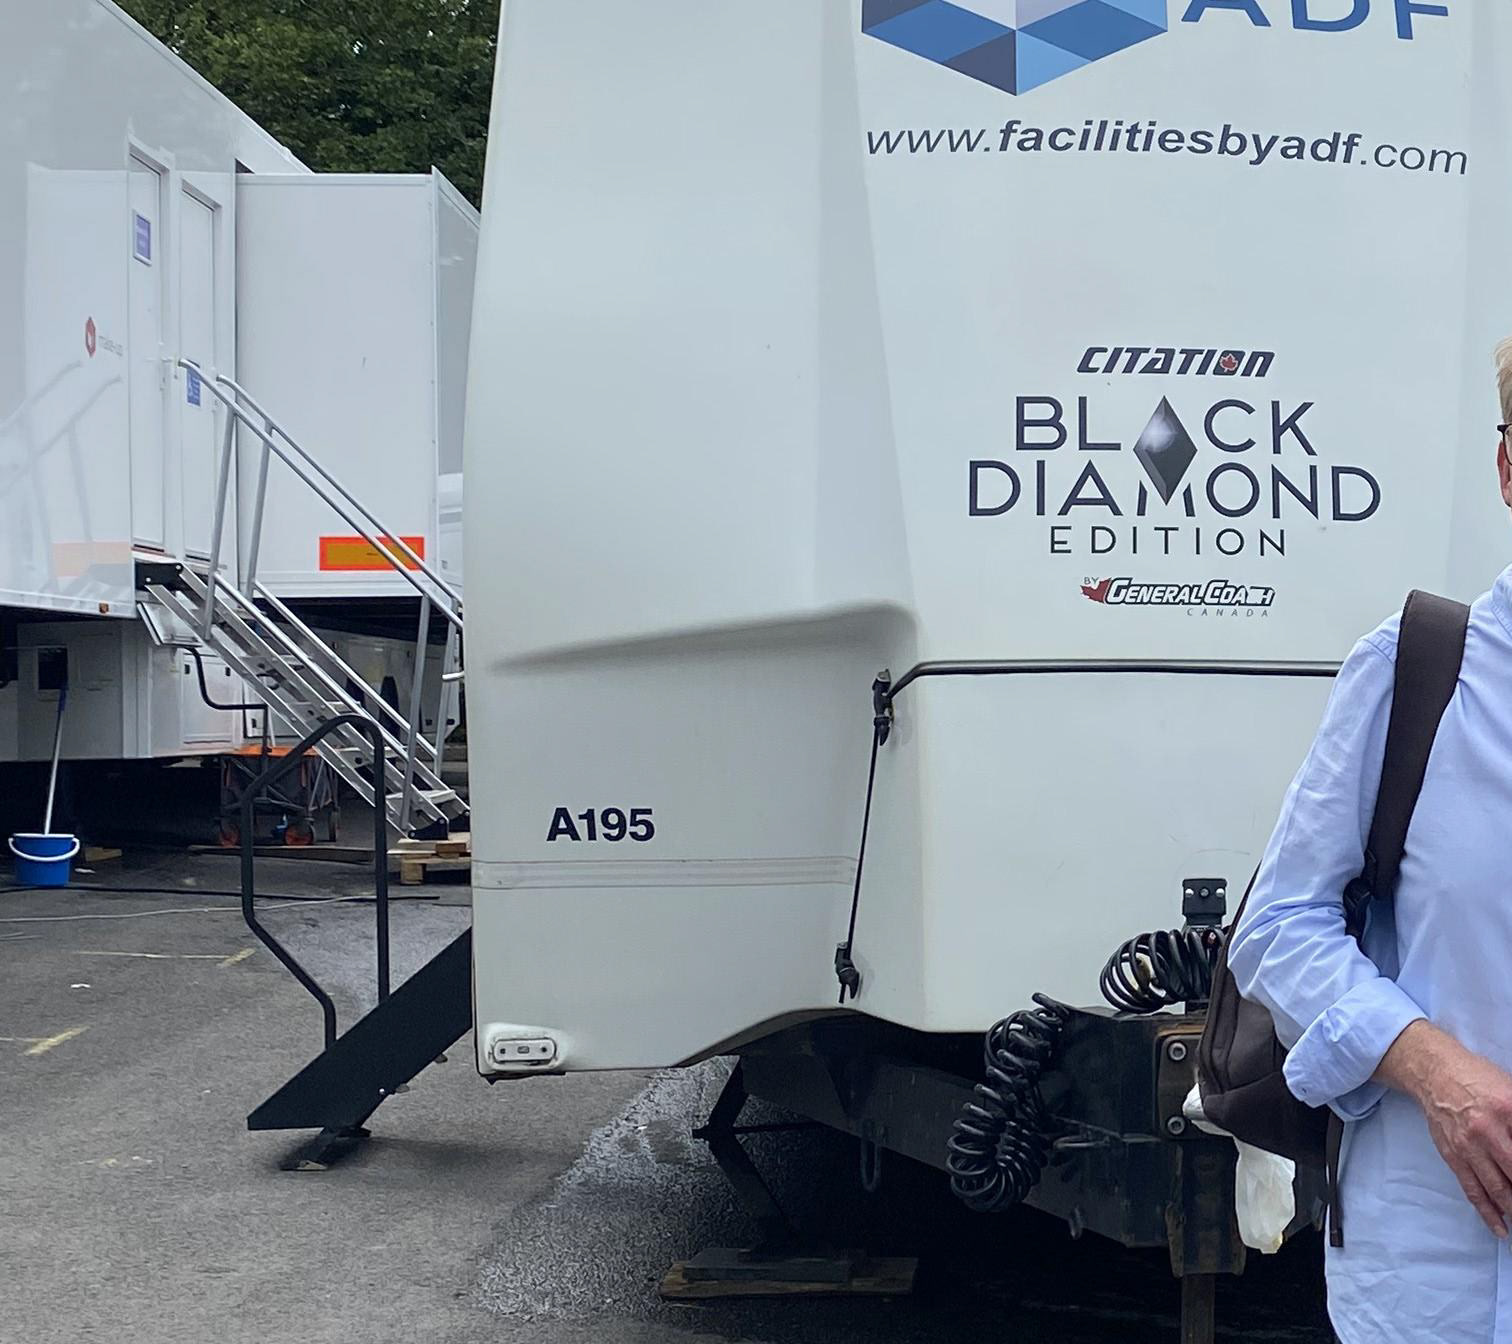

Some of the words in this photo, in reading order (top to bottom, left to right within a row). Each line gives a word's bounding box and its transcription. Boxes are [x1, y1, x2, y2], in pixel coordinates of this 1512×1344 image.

[866, 119, 1469, 177] www.facilitiesbyadf.com
[967, 459, 1382, 523] DIAMOND
[1049, 525, 1286, 557] EDITION
[1083, 576, 1099, 586] BY
[1186, 608, 1269, 618] CANADA
[546, 806, 656, 843] A195
